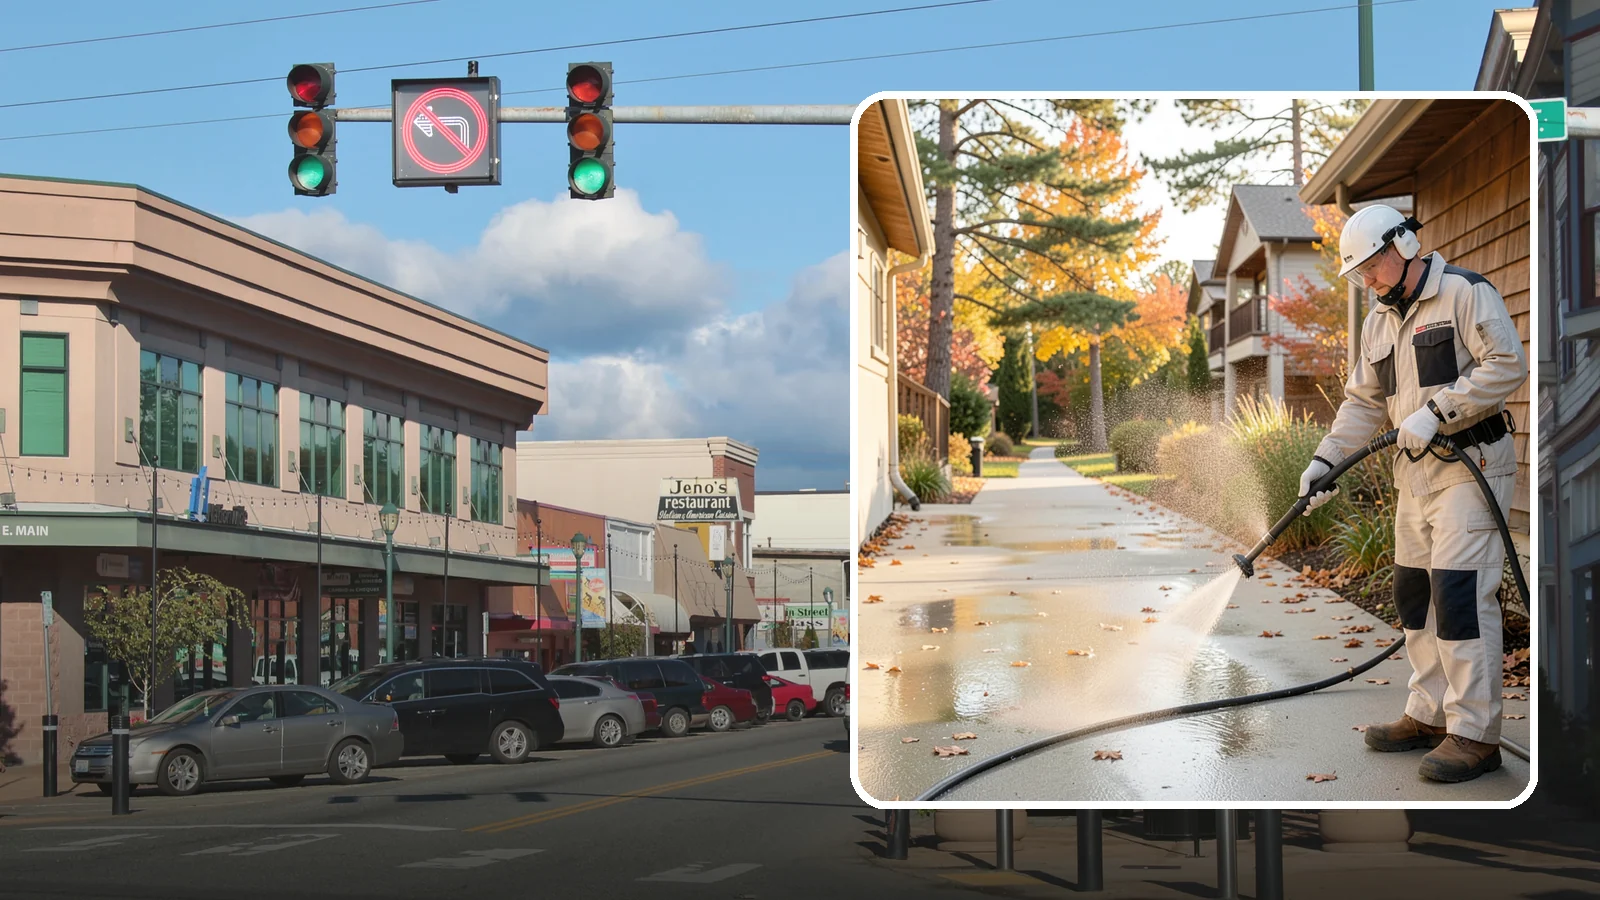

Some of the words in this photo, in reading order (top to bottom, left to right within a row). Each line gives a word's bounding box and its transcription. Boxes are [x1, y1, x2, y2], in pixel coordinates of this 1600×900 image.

[670, 479, 727, 494] Jeno's
[665, 497, 730, 509] restaurant
[658, 510, 681, 520] Italian
[686, 510, 714, 520] American
[714, 510, 738, 520] Cuisine
[2, 525, 13, 536] E.
[15, 525, 49, 536] MAIN
[797, 607, 829, 617] Street
